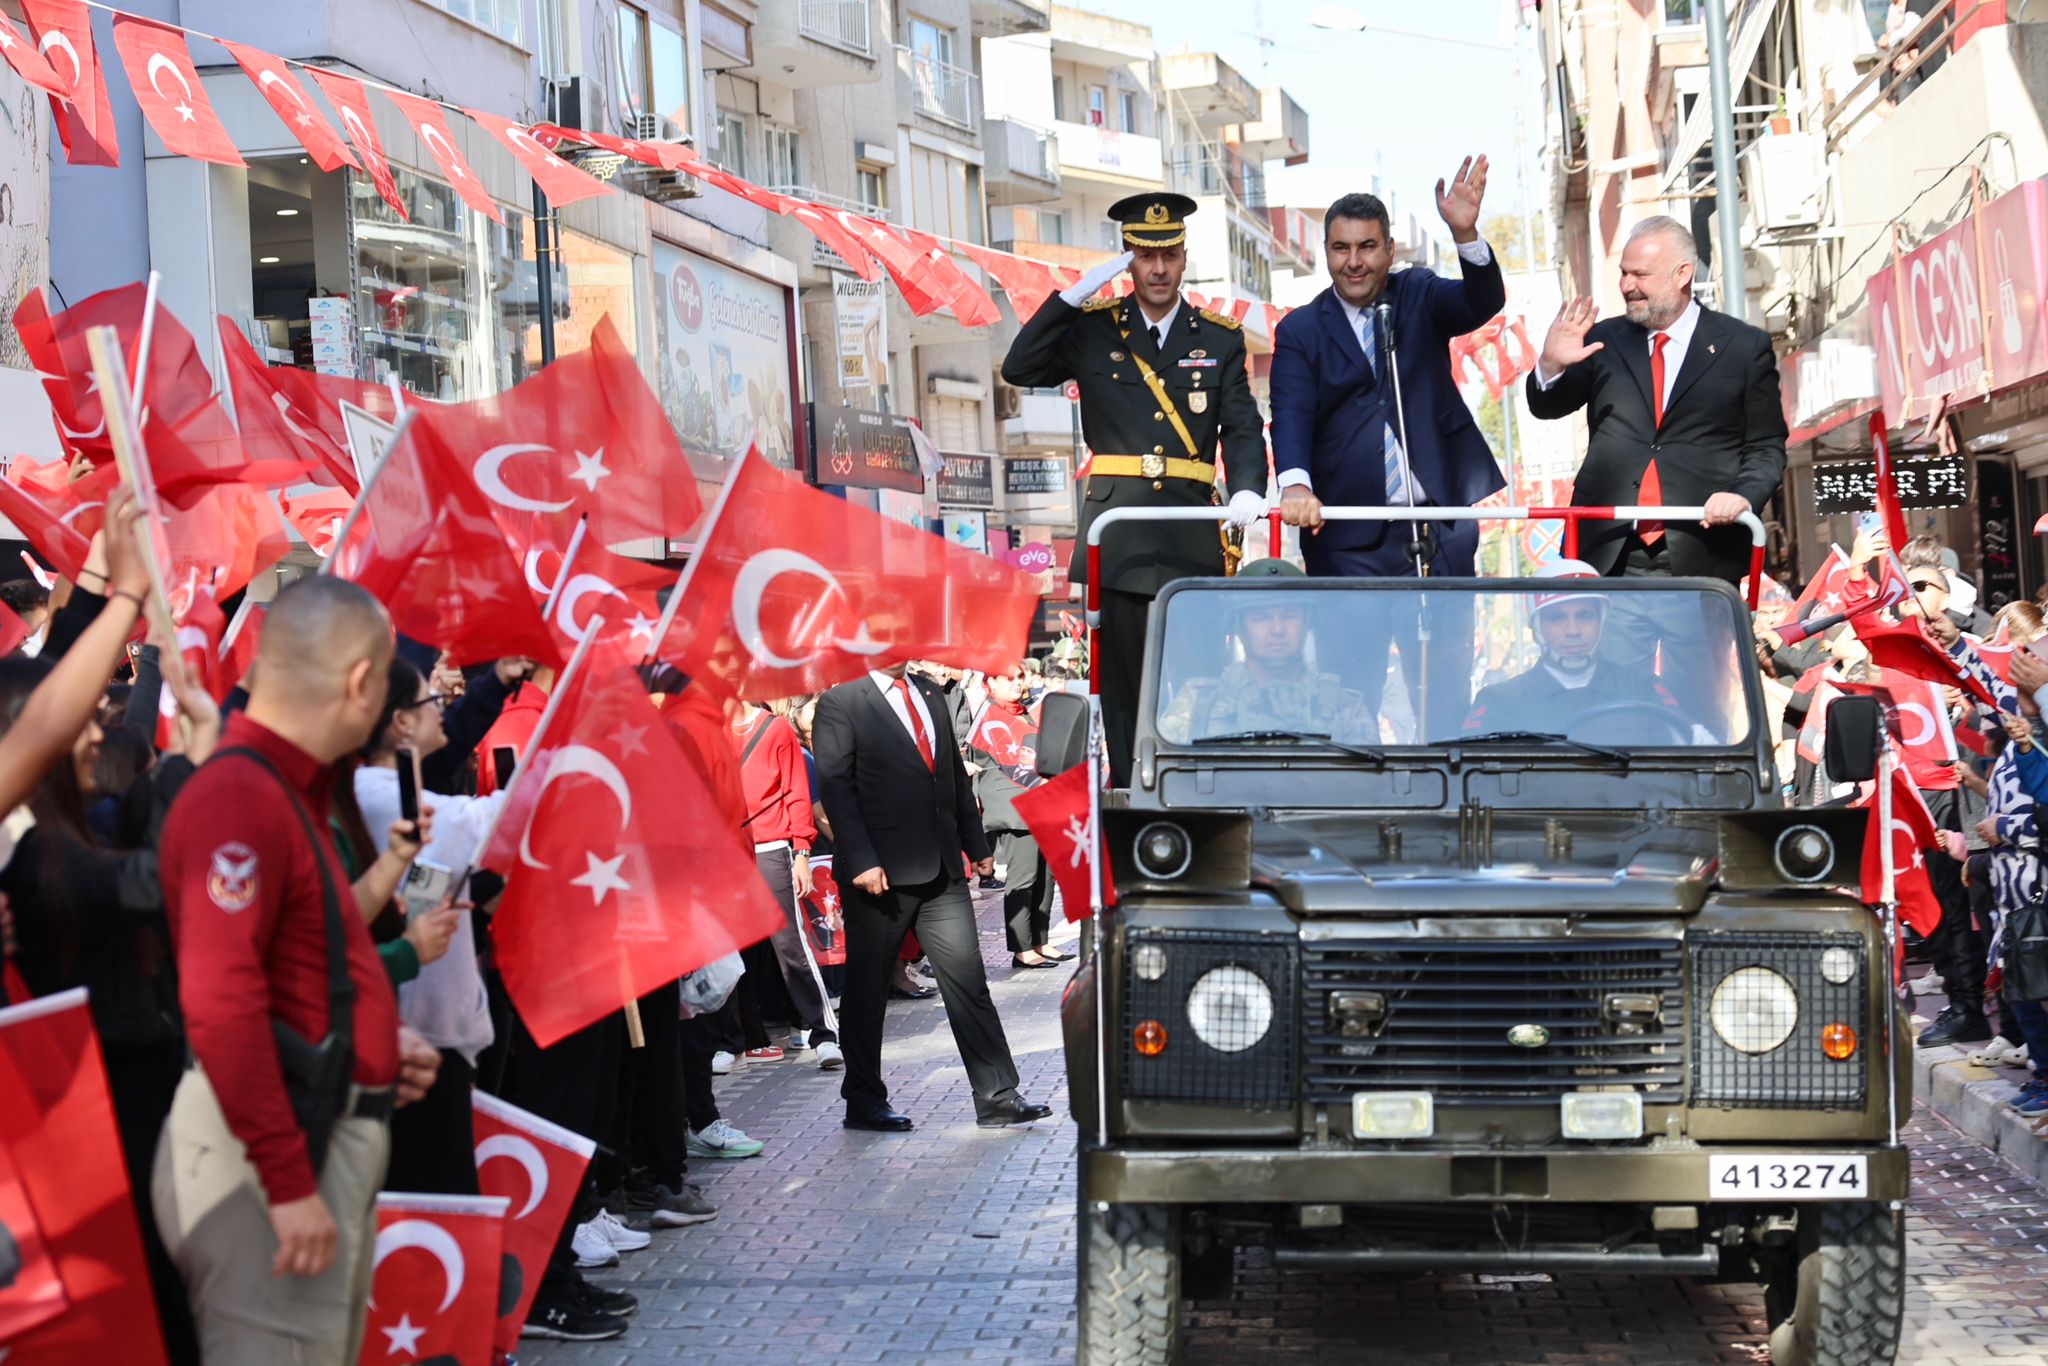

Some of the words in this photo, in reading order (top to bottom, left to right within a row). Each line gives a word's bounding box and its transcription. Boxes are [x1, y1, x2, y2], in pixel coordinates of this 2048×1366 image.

[943, 456, 985, 479] AVUKAT
[1013, 460, 1060, 472] BEŞKAYA
[1019, 549, 1049, 566] eve
[1721, 1164, 1860, 1188] 413274
